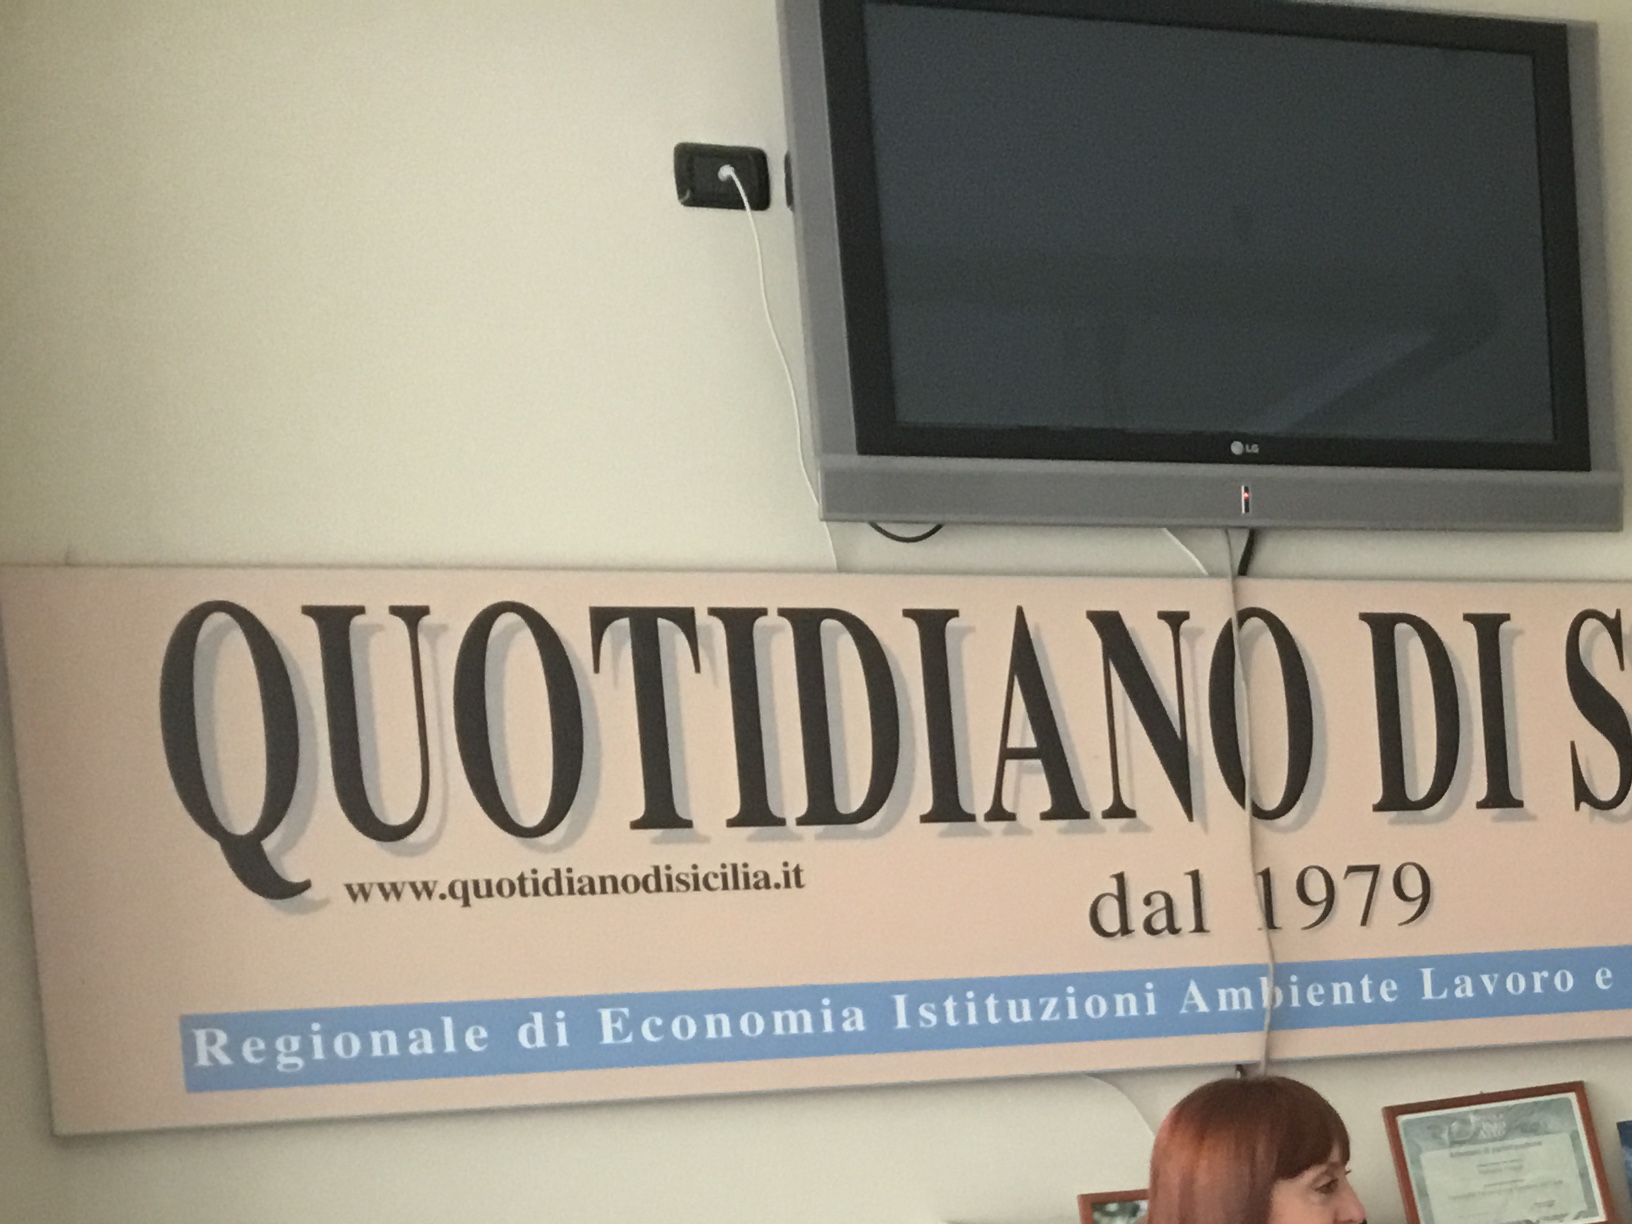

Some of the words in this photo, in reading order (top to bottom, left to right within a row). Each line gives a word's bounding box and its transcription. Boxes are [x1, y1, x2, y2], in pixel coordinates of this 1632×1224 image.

[1245, 443, 1260, 454] LG
[159, 600, 1314, 901] QUOTIDIANO
[1359, 611, 1524, 813] DI
[344, 861, 806, 908] www.quotidianodisicilia.it
[1088, 869, 1210, 938] dal
[1256, 861, 1432, 931] 1979
[190, 1016, 490, 1073] Regionale
[517, 1010, 571, 1050] di
[598, 997, 868, 1046] Economia
[891, 981, 1157, 1030] Istituzioni
[1179, 973, 1400, 1015] Ambiente
[1420, 966, 1575, 1001] Lavoro
[1594, 968, 1614, 990] e
